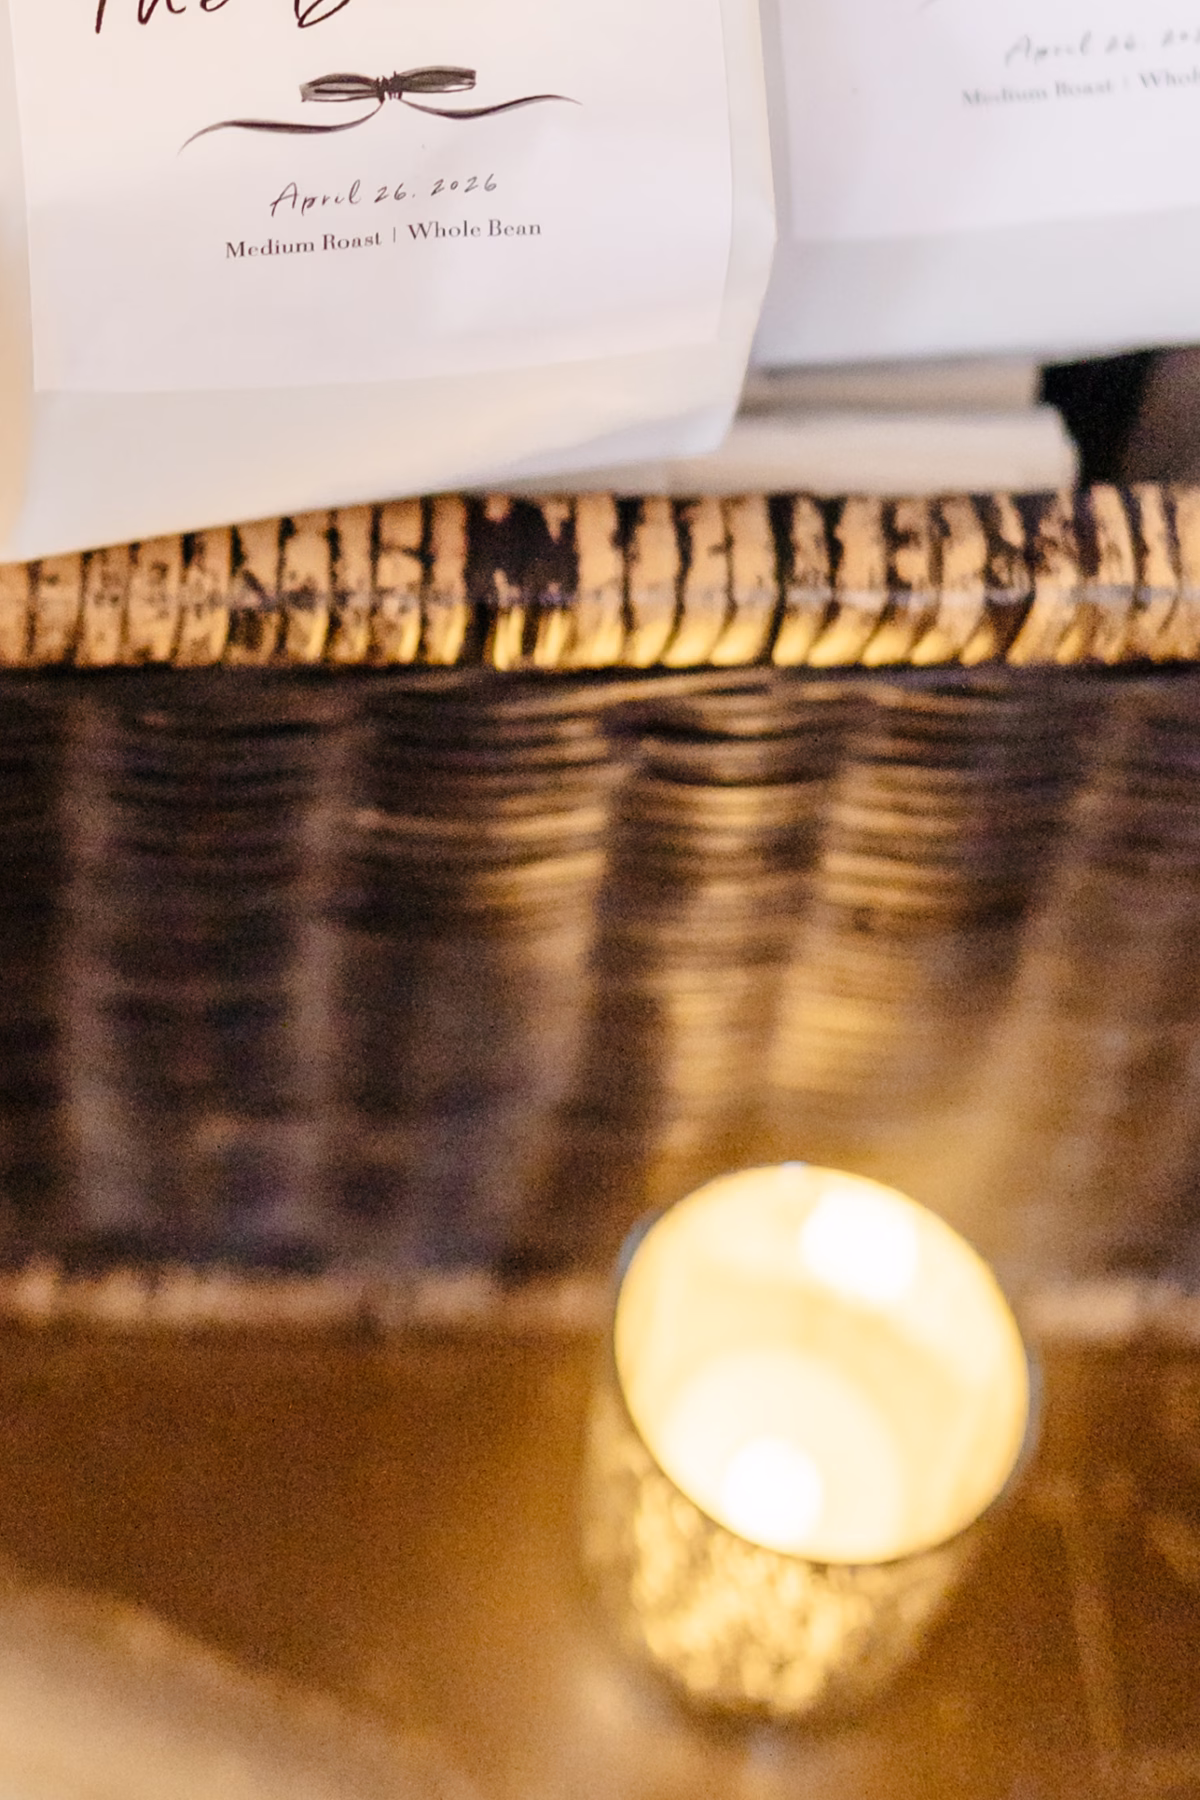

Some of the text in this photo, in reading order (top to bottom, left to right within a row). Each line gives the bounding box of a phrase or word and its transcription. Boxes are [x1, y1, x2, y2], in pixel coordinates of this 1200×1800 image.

[268, 178, 362, 218] April
[429, 172, 498, 197] 2026
[224, 237, 316, 260] Medium
[321, 231, 383, 252] Roast
[406, 218, 482, 241] Whole
[487, 217, 543, 238] Bean
